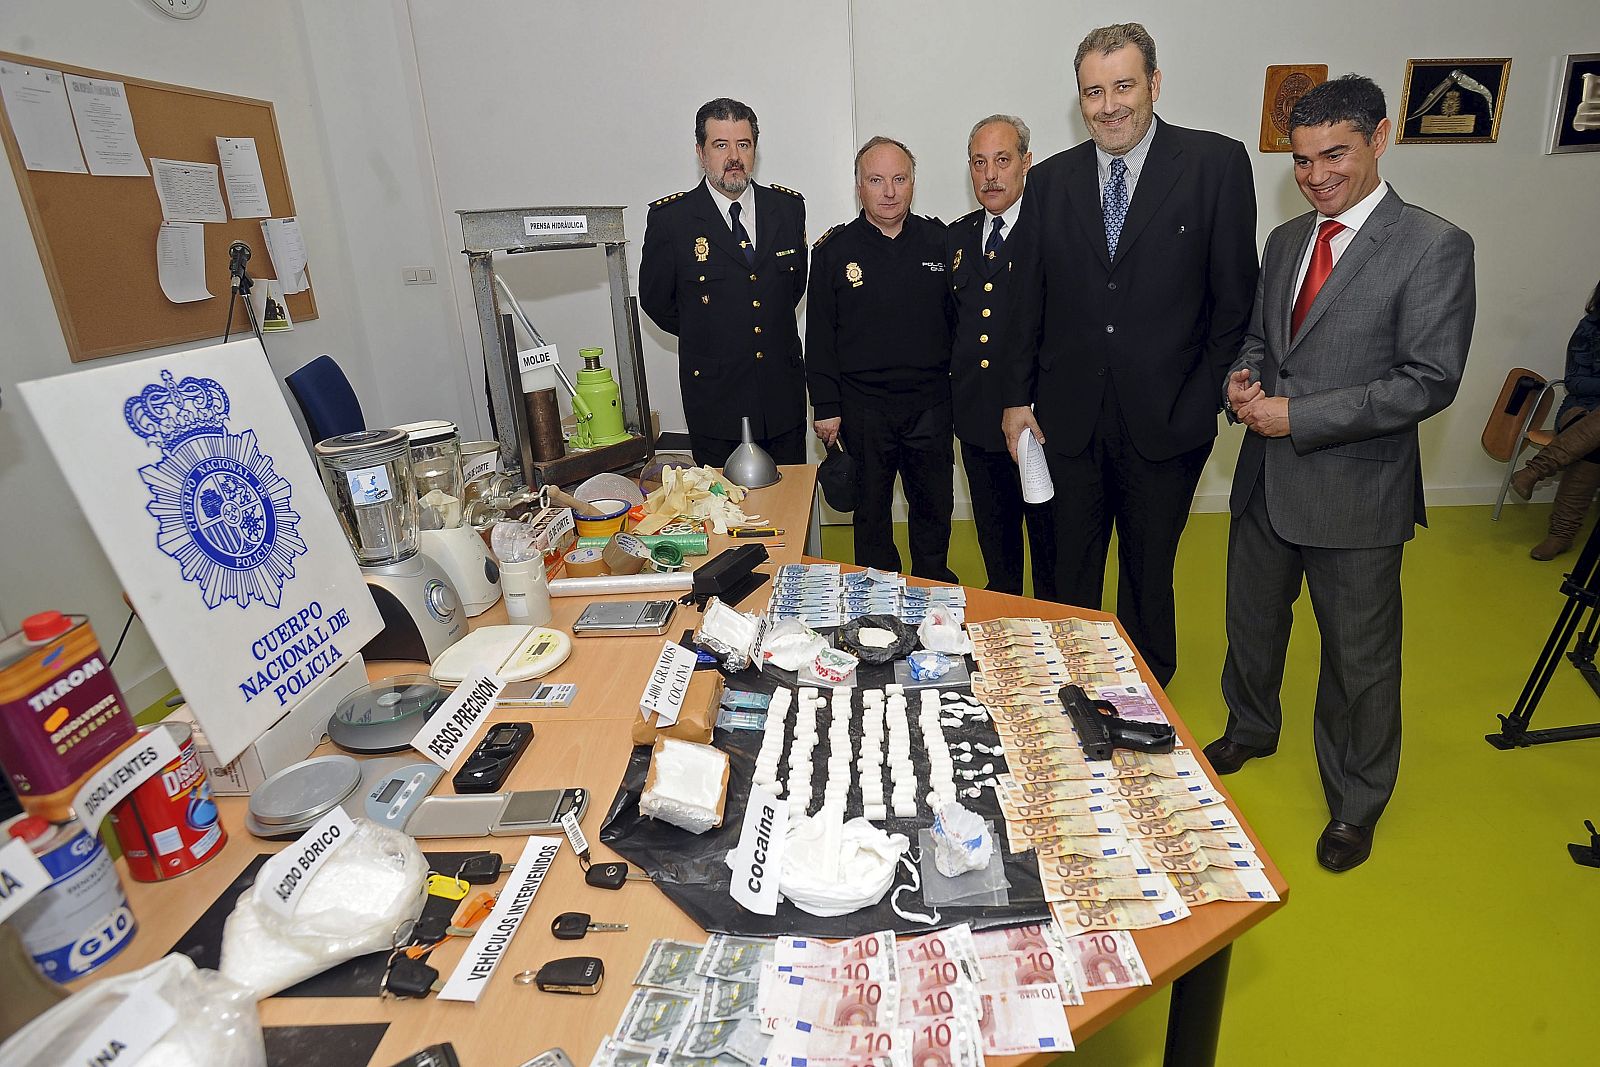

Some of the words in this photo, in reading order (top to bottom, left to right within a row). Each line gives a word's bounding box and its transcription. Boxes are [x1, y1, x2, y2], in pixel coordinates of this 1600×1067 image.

[529, 222, 551, 230] PRENSA
[551, 220, 584, 230] HIDRÁULICA
[522, 352, 551, 367] MOLDE
[475, 461, 490, 474] CORTE
[184, 478, 198, 532] CUERPO
[197, 460, 250, 480] NACIONAL
[255, 484, 268, 500] DE
[556, 515, 570, 532] CORTE
[235, 542, 271, 567] POLICIA
[251, 601, 323, 661] CUERPO
[238, 626, 330, 703] NACIONAL
[326, 607, 351, 635] DE
[653, 644, 677, 684] GRAMOS
[27, 657, 105, 712] TKROM
[273, 644, 343, 706] POLICIA
[667, 663, 691, 706] COCAÍNA
[644, 683, 663, 708] 2.400
[427, 722, 464, 760] PESOS
[452, 676, 499, 731] PRECISIÓN
[56, 705, 120, 755] DILUENTE
[84, 746, 158, 816] DISOLVENTES
[1118, 785, 1145, 797] 50
[1023, 793, 1048, 803] 50
[1018, 806, 1044, 817] 50
[1129, 807, 1157, 819] 50
[1022, 825, 1049, 837] 50
[1138, 820, 1166, 835] 50
[1154, 839, 1183, 853] 50
[272, 866, 303, 903] ÁCIDO
[298, 824, 341, 871] BÓRICO
[1055, 863, 1086, 878] 50
[1160, 856, 1192, 870] 50
[1060, 882, 1091, 897] 50
[466, 916, 519, 982] VEHÍCULOS
[507, 844, 558, 916] INTERVENIDOS
[1076, 907, 1109, 928] 50
[79, 914, 127, 956] G10
[1090, 934, 1118, 955] 10
[854, 937, 880, 960] 10
[919, 938, 946, 961] 10
[843, 963, 870, 981] 10
[1026, 951, 1055, 972] 10
[930, 962, 958, 985] 10
[855, 983, 882, 1006] 10
[924, 991, 954, 1016] 10
[1041, 988, 1056, 1000] 10
[864, 1032, 892, 1054] 10
[923, 1023, 952, 1049] 10
